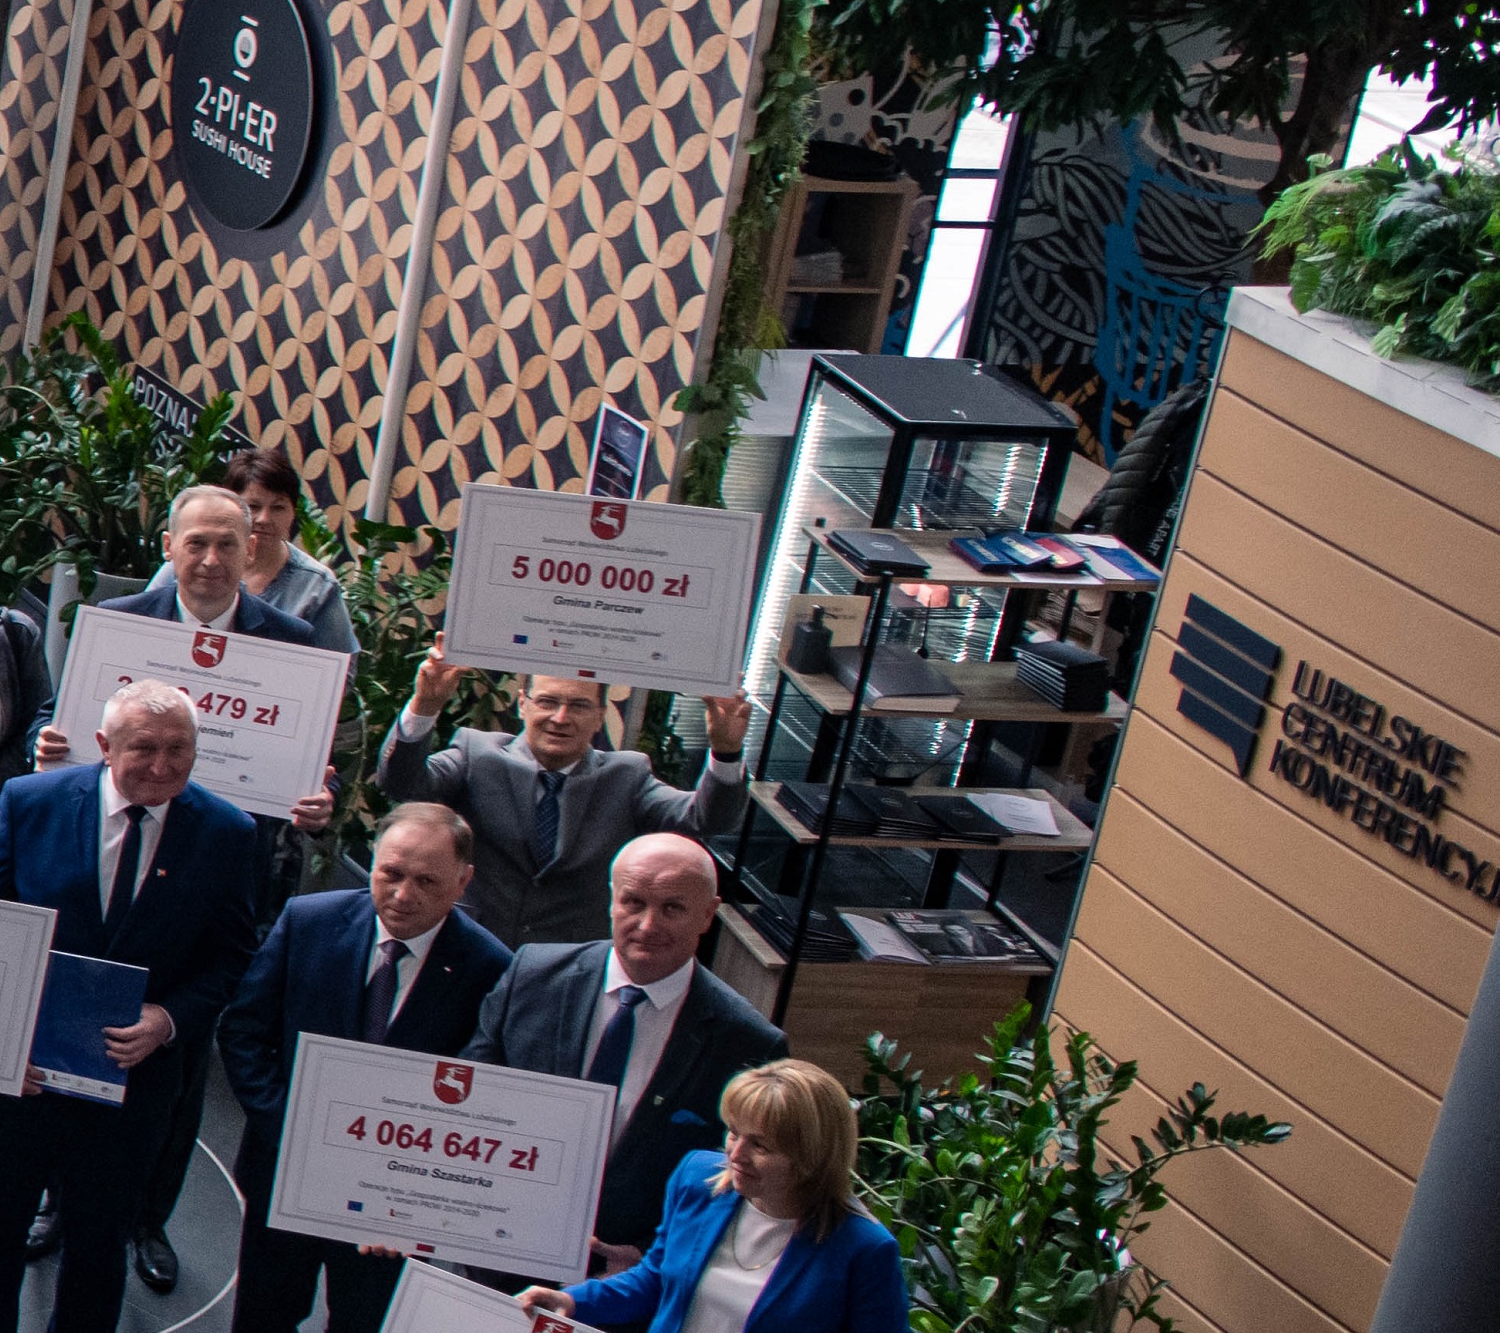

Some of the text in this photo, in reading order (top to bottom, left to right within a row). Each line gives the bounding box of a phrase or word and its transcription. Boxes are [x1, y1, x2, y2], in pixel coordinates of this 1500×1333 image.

[191, 119, 272, 179] SUSHI HOUSE
[511, 555, 689, 597] 5 000 000 zł
[552, 594, 644, 614] Gmina Parczew
[1282, 702, 1447, 820] CENTRUM
[1291, 660, 1467, 789] LUBELSKIE
[1268, 738, 1500, 907] KONFERENCYJ
